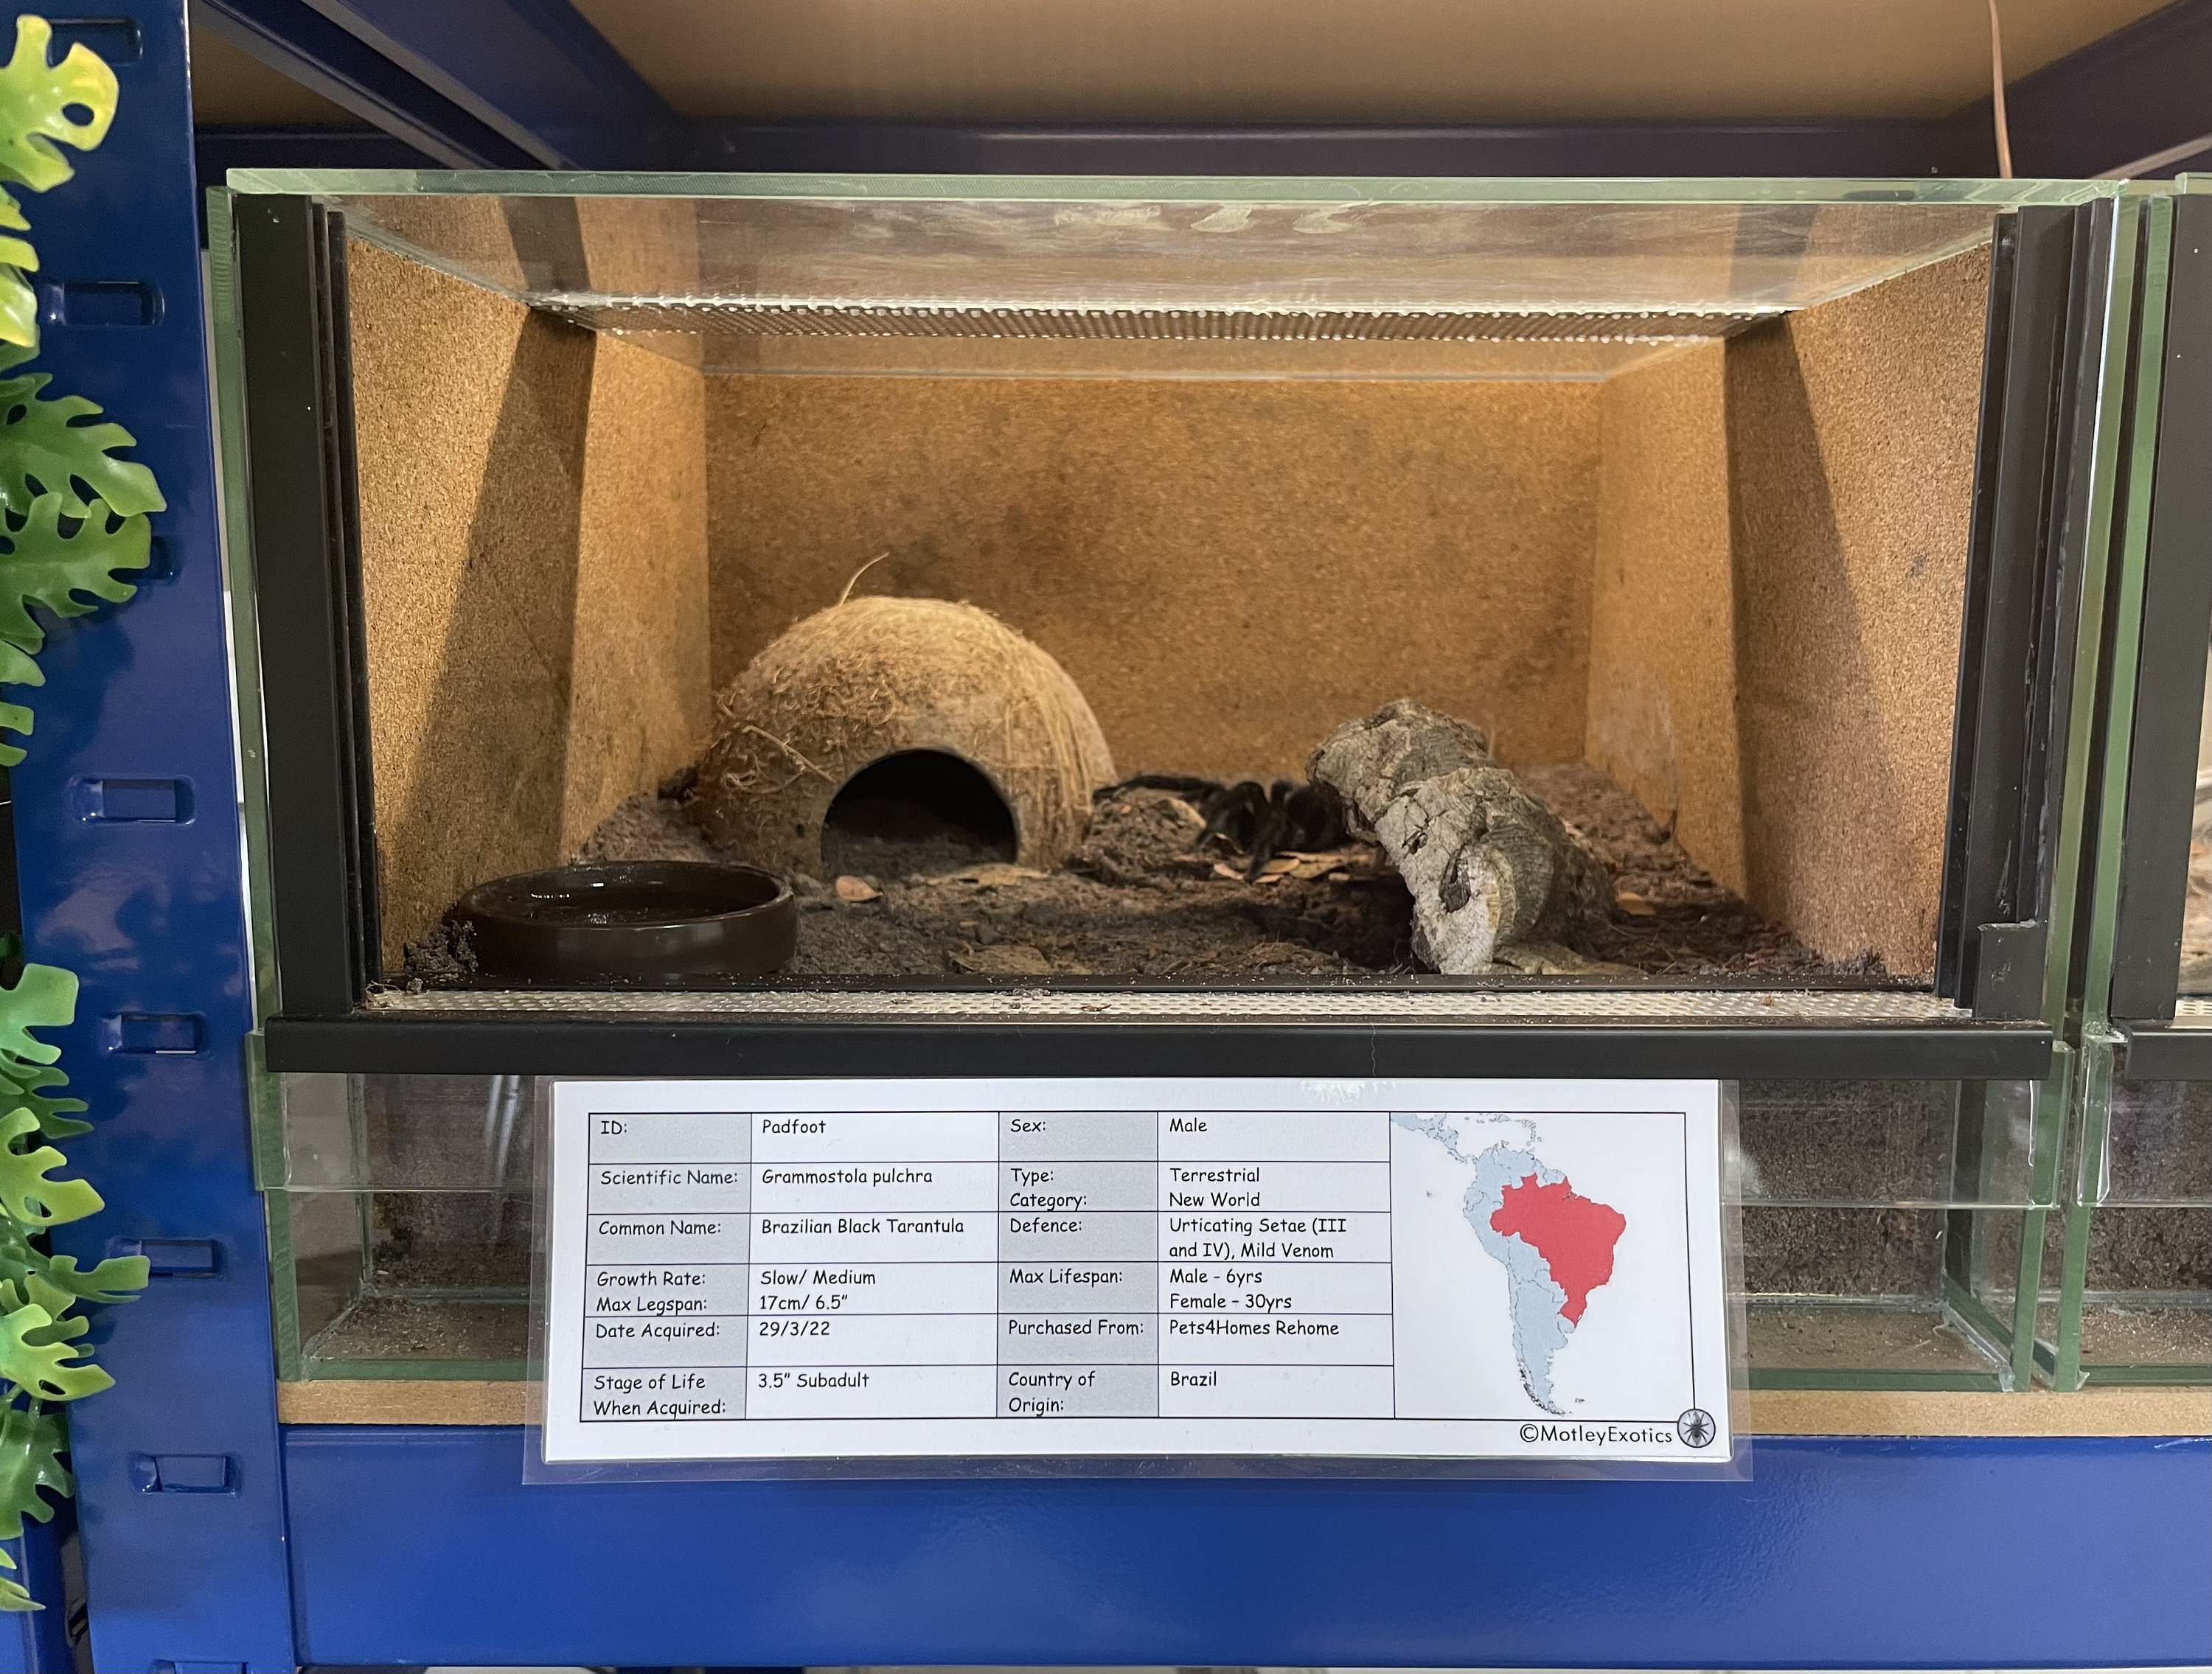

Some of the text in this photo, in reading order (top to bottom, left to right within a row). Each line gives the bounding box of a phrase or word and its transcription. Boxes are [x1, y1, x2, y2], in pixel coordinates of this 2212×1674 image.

[600, 1120, 627, 1135] ID:
[762, 1119, 827, 1134] Padfoot
[1010, 1118, 1046, 1133] Sex:
[1169, 1117, 1208, 1132] Male
[600, 1169, 737, 1185] Scientific Name:
[762, 1168, 933, 1188] Grammostola pulchra
[1010, 1168, 1054, 1187] Type:
[1169, 1167, 1259, 1182] Terrestrial
[1009, 1192, 1087, 1212] Category:
[1169, 1191, 1260, 1207] New World
[599, 1220, 721, 1235] Common Name:
[762, 1218, 964, 1234] Brazilian Black Tarantula
[1010, 1217, 1082, 1234] Defence:
[1170, 1217, 1346, 1237] Urticating Setae (III
[1169, 1241, 1334, 1260] and IV), Mild Venom
[597, 1270, 706, 1287] Growth Rate:
[760, 1269, 876, 1285] Slow/ Medium
[1009, 1268, 1122, 1288] Max Lifespan:
[1169, 1268, 1208, 1283] Male
[1226, 1268, 1262, 1288] 6yrs
[596, 1296, 707, 1316] Max Legspan:
[760, 1294, 810, 1311] 17cm/
[1170, 1293, 1227, 1309] Female
[1245, 1294, 1292, 1314] 30yrs
[596, 1322, 720, 1342] Date Acquired:
[759, 1320, 830, 1337] 29/3/22
[1009, 1319, 1144, 1336] Purchased From:
[1169, 1319, 1340, 1336] Pets4Homes Rehome
[594, 1373, 706, 1393] Stage of Life
[796, 1371, 869, 1388] Subadult
[1009, 1370, 1096, 1391] Country of
[1171, 1370, 1217, 1387] Brazil
[594, 1398, 726, 1420] When Acquired:
[1008, 1397, 1065, 1418] Origin:
